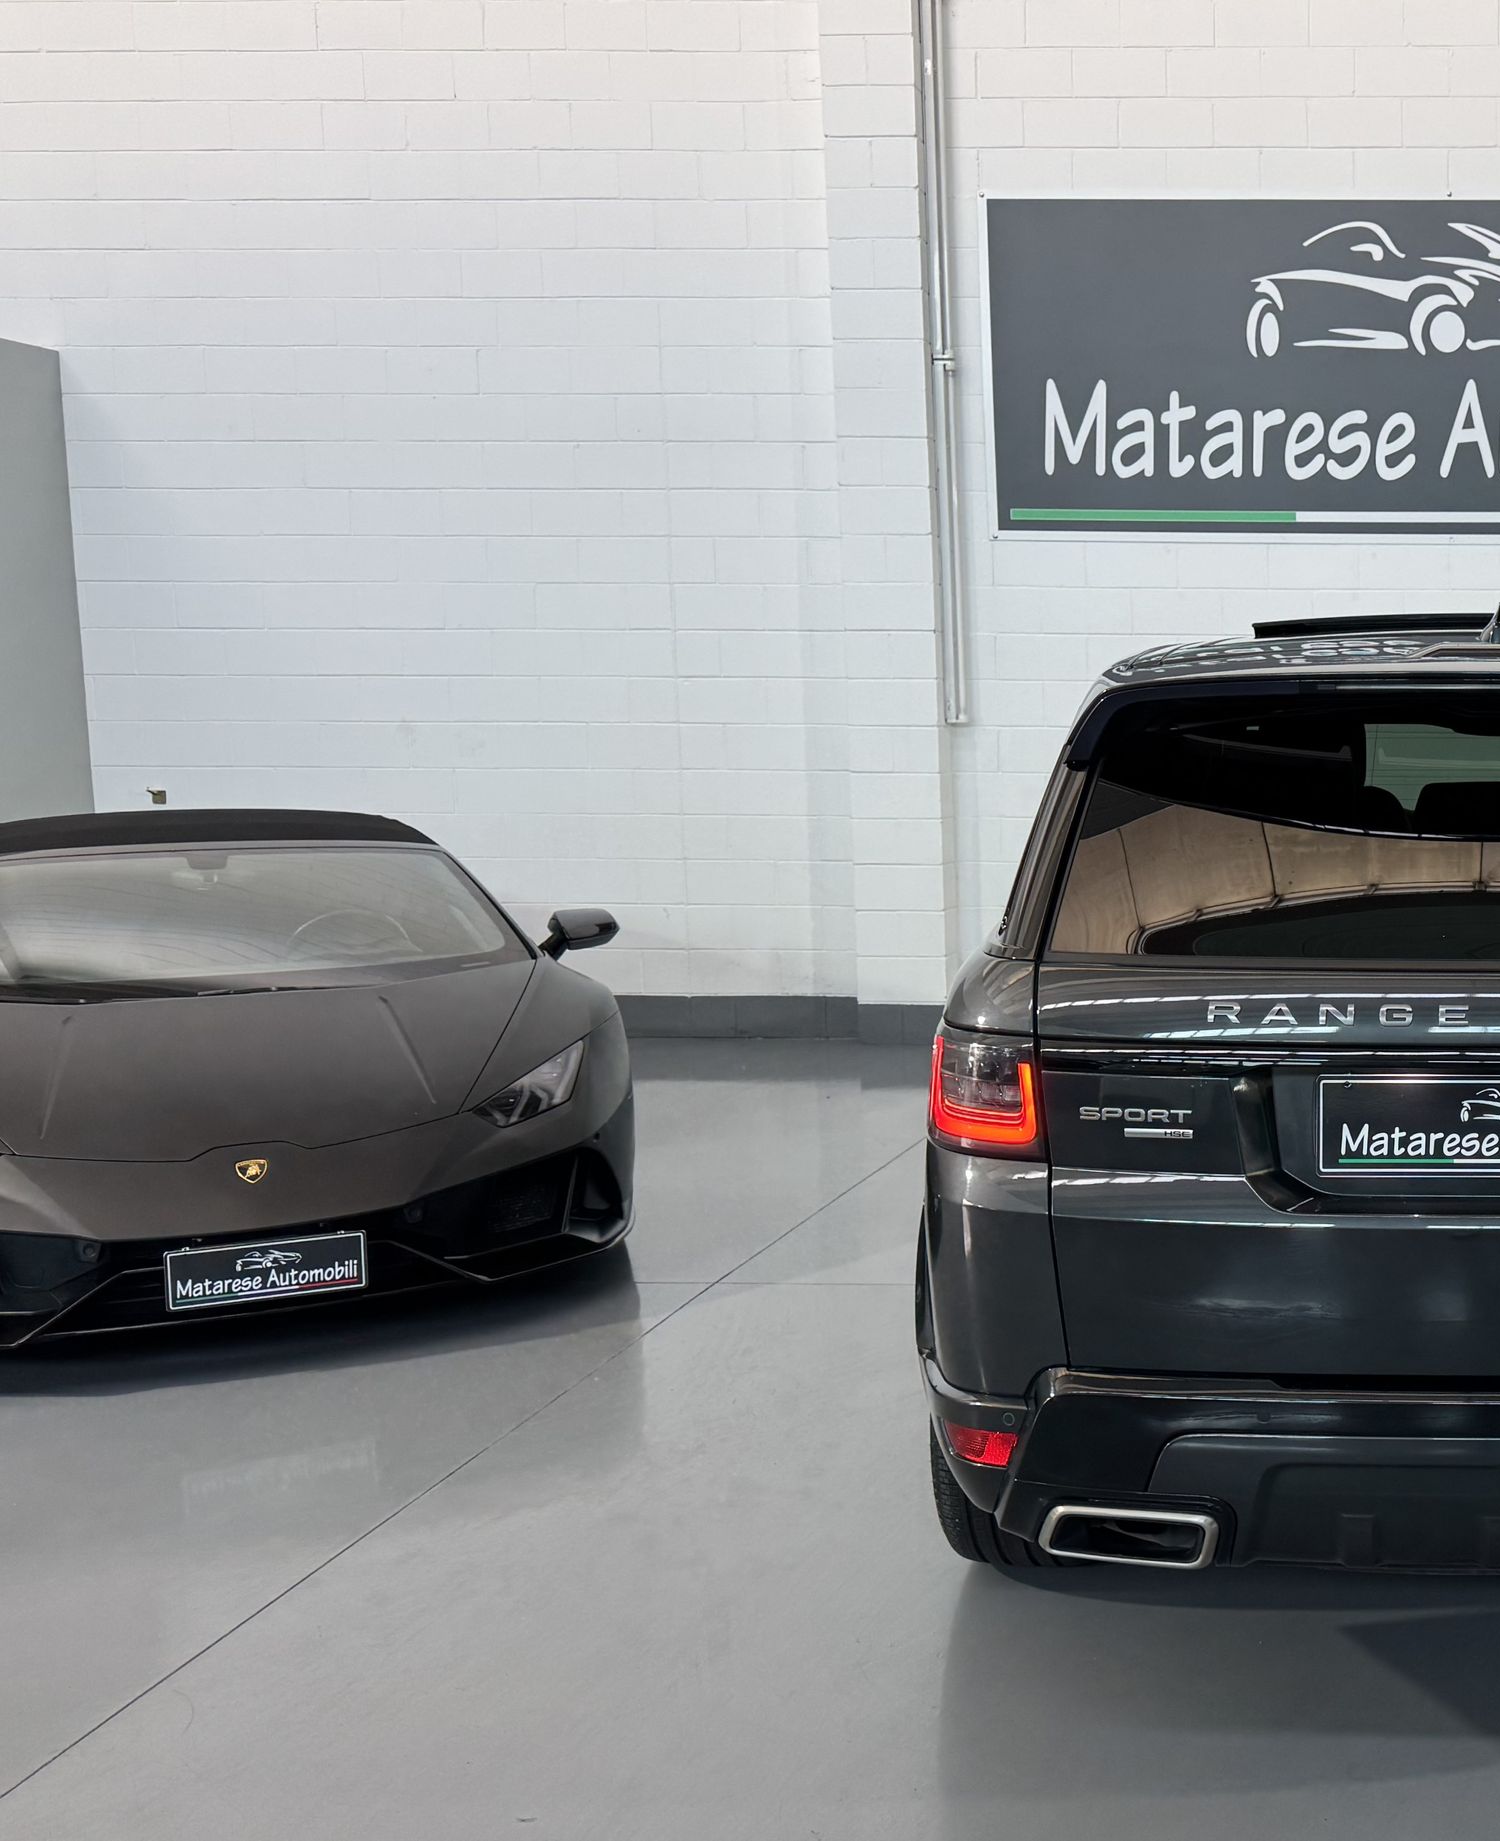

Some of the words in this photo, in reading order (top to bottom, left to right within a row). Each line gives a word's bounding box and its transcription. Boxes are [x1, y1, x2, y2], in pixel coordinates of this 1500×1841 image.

[1043, 377, 1416, 481] Matarese
[1207, 1001, 1470, 1027] RANGE
[1079, 1106, 1193, 1123] SPORT
[1163, 1130, 1192, 1138] HSE
[1339, 1123, 1500, 1157] Matarese
[176, 1275, 263, 1300] Matarese
[266, 1259, 358, 1288] Automobili
